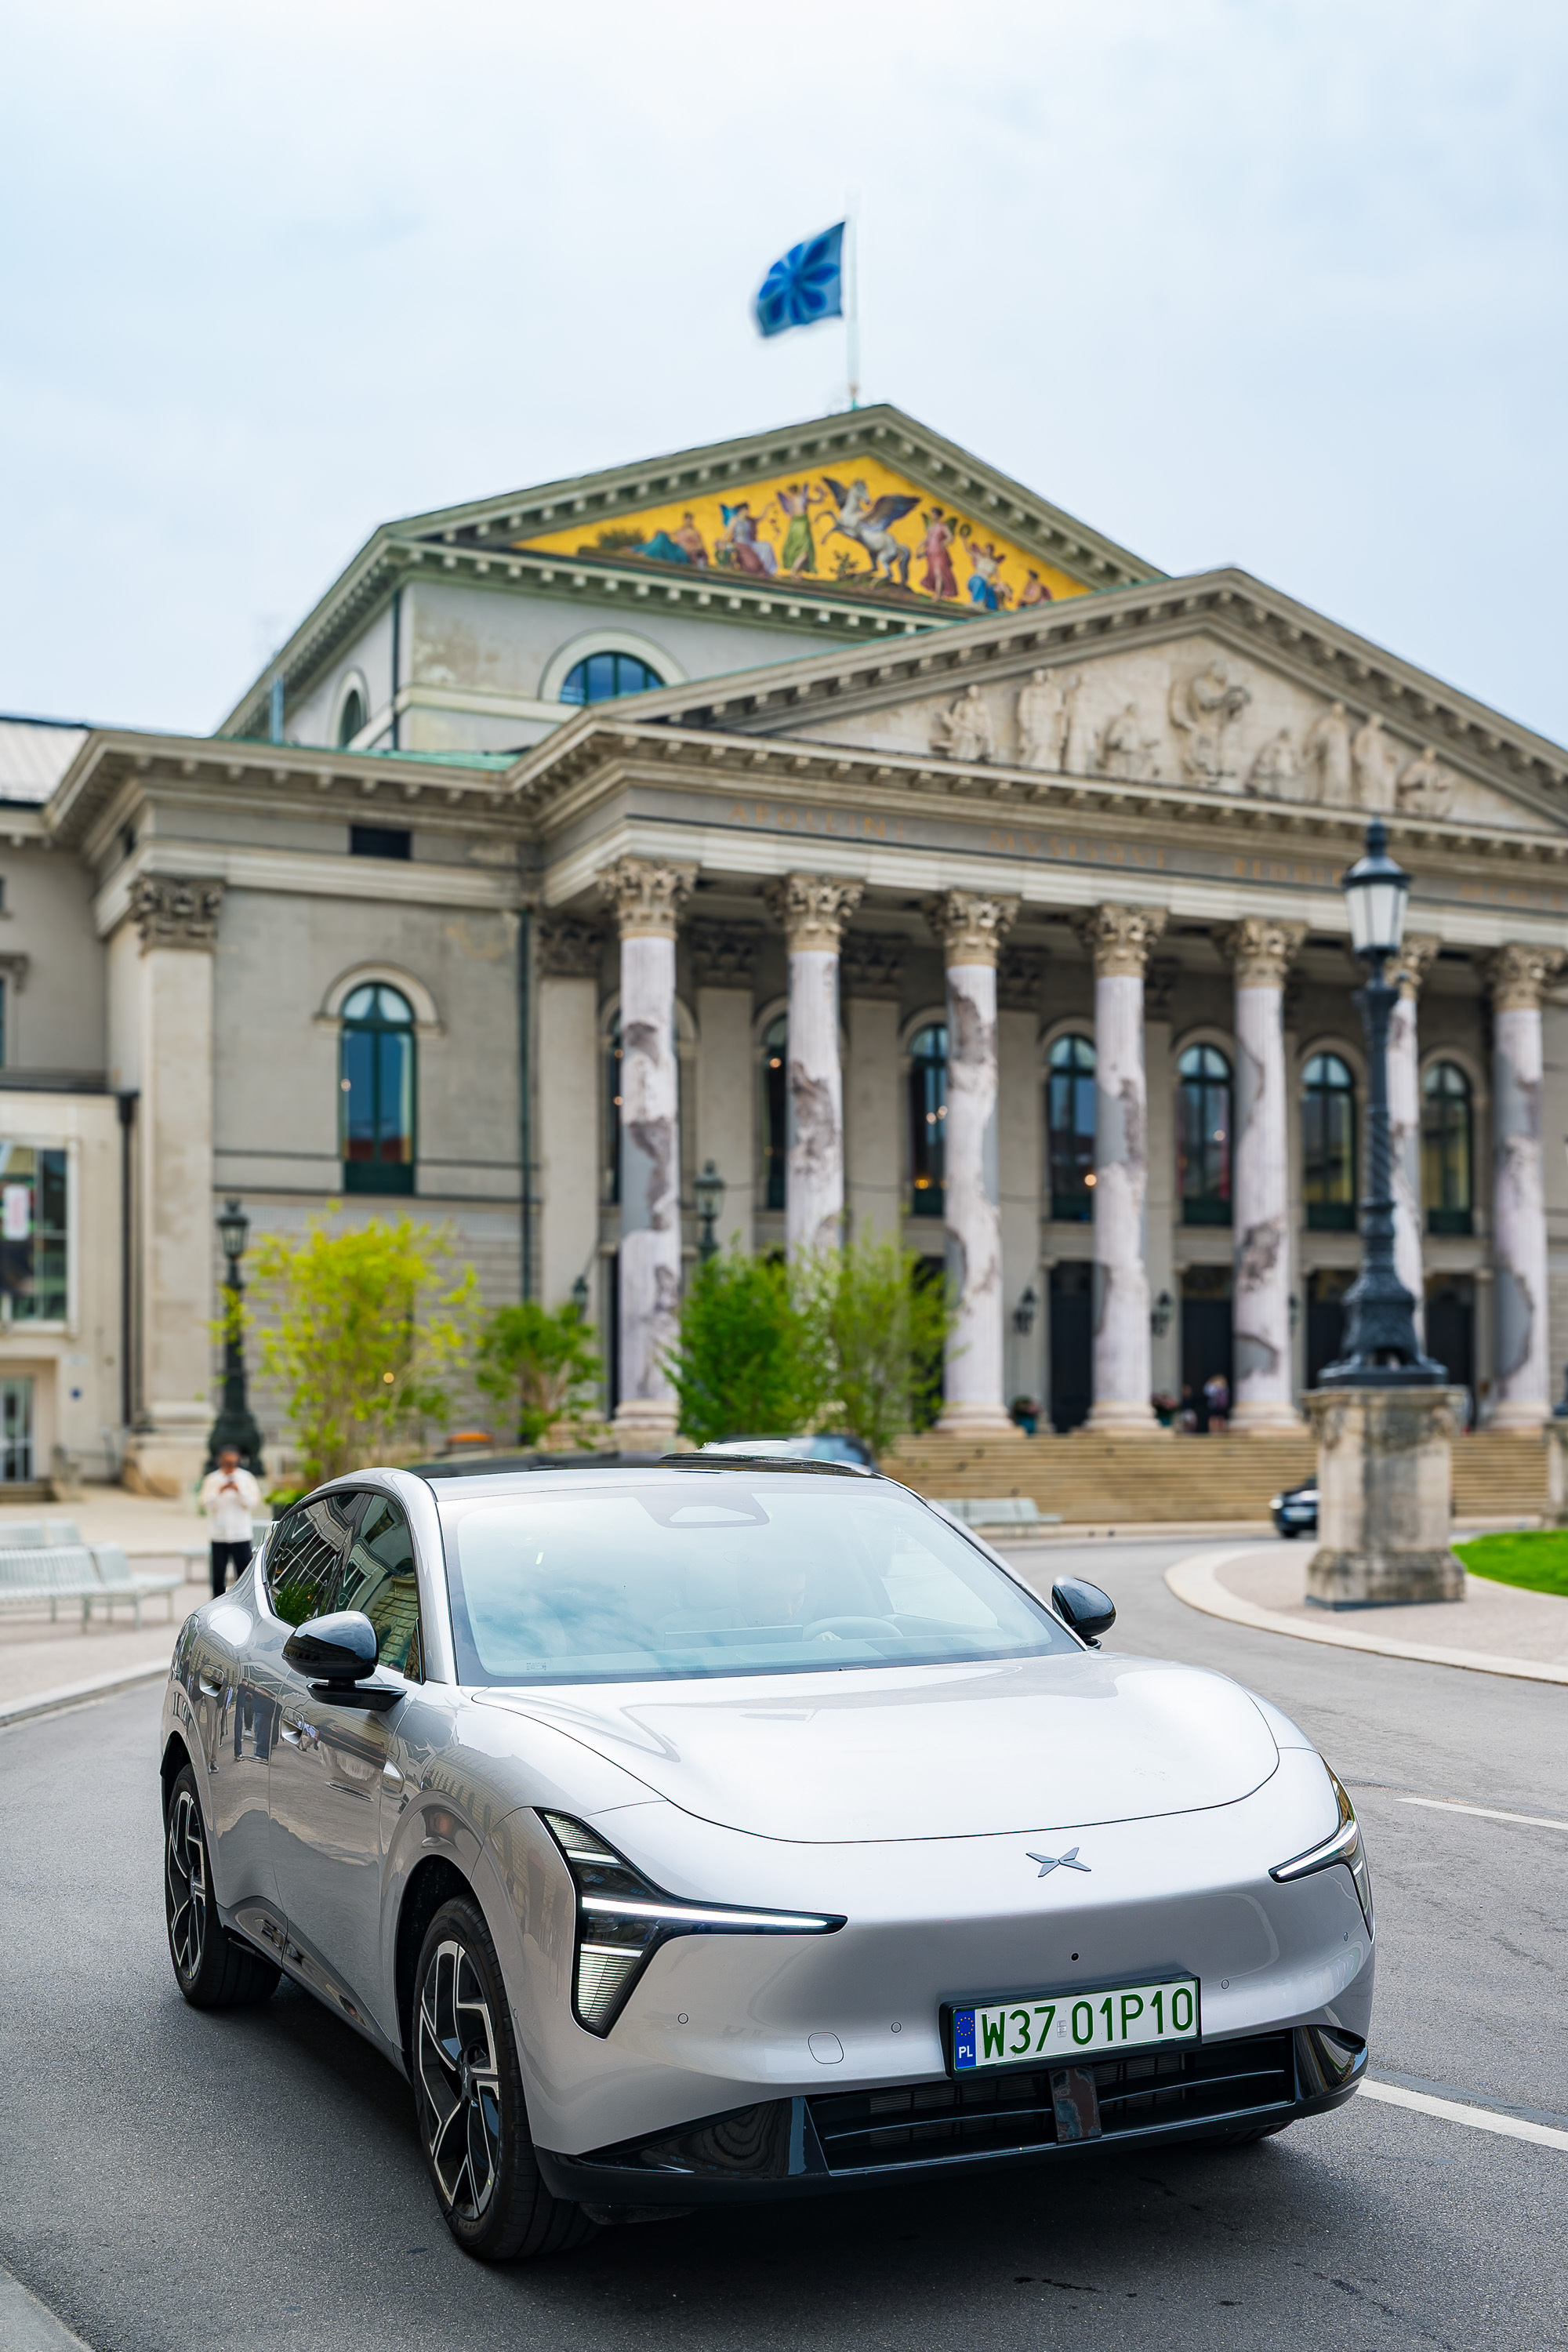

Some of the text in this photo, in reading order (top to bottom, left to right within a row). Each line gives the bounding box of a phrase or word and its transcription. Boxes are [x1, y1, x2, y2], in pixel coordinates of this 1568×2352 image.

[729, 803, 904, 840] APOLLINI
[982, 1987, 1193, 2059] W37 01P10
[958, 2045, 973, 2059] PL
